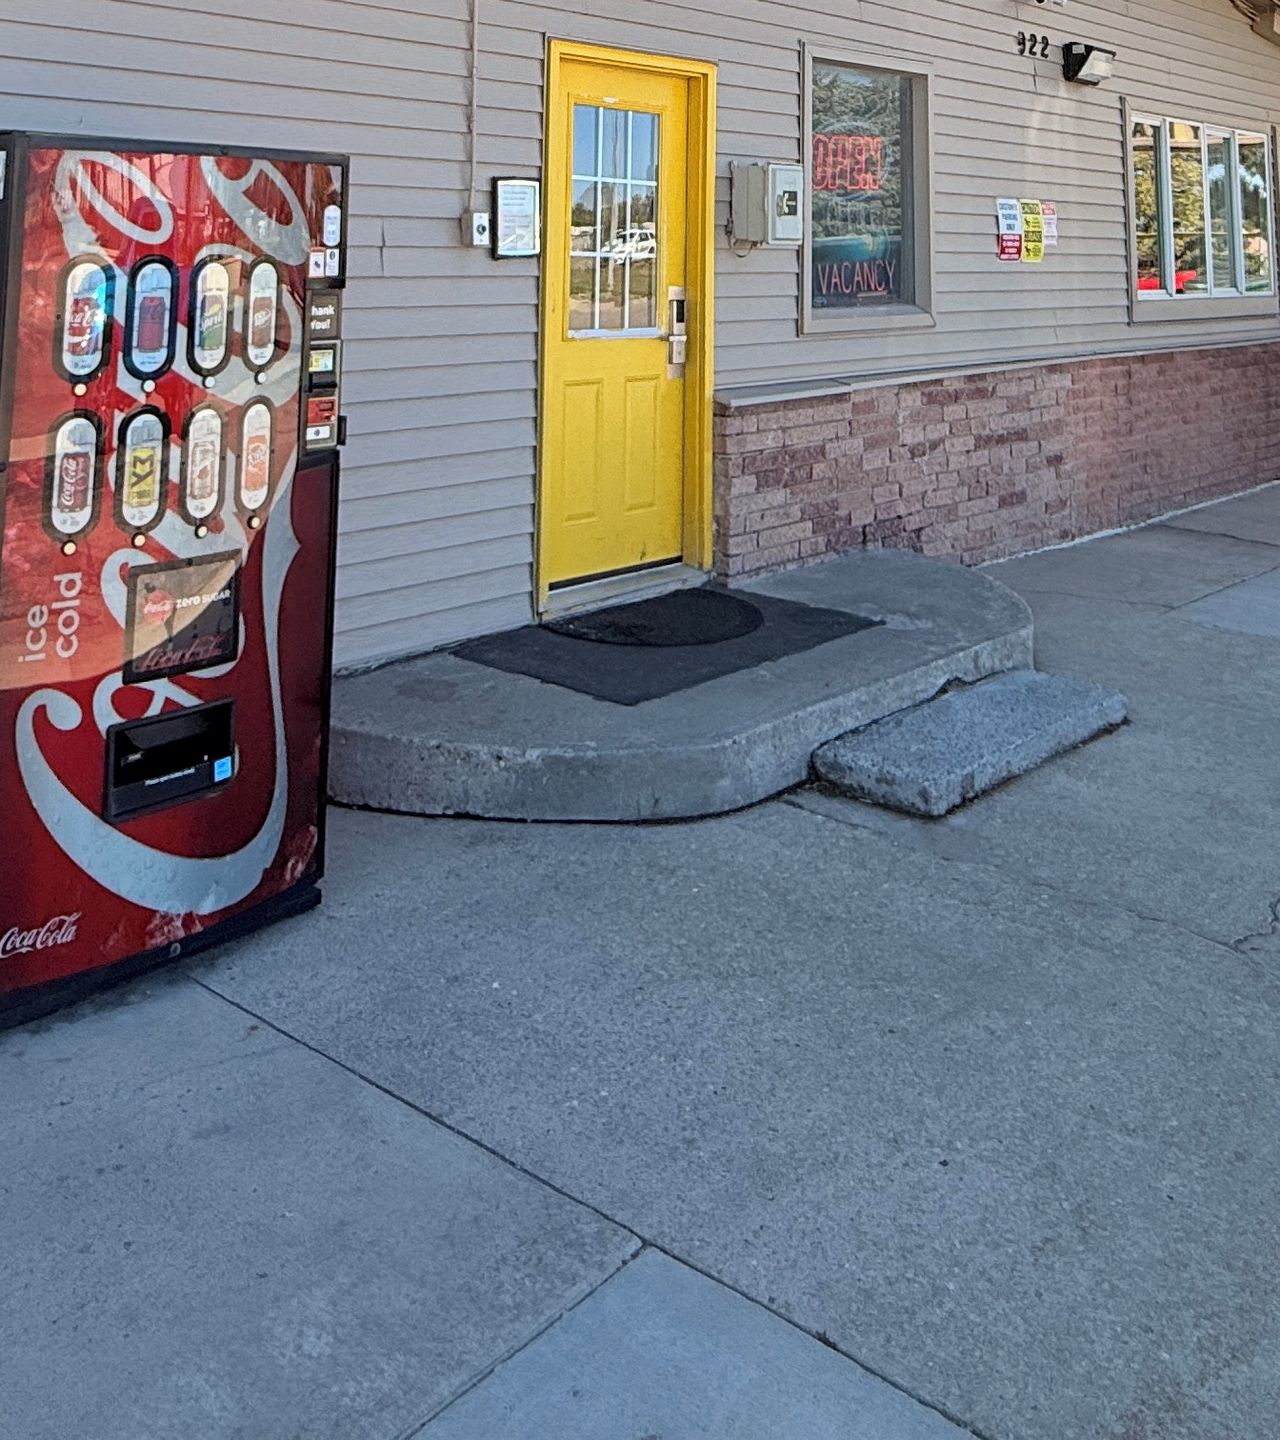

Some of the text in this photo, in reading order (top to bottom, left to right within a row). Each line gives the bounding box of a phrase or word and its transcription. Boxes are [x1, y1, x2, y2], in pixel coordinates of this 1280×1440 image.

[812, 134, 881, 190] OPEN
[818, 260, 895, 294] VACANCY
[51, 572, 82, 658] cold
[202, 590, 231, 604] SUGAR
[18, 604, 48, 662] ice
